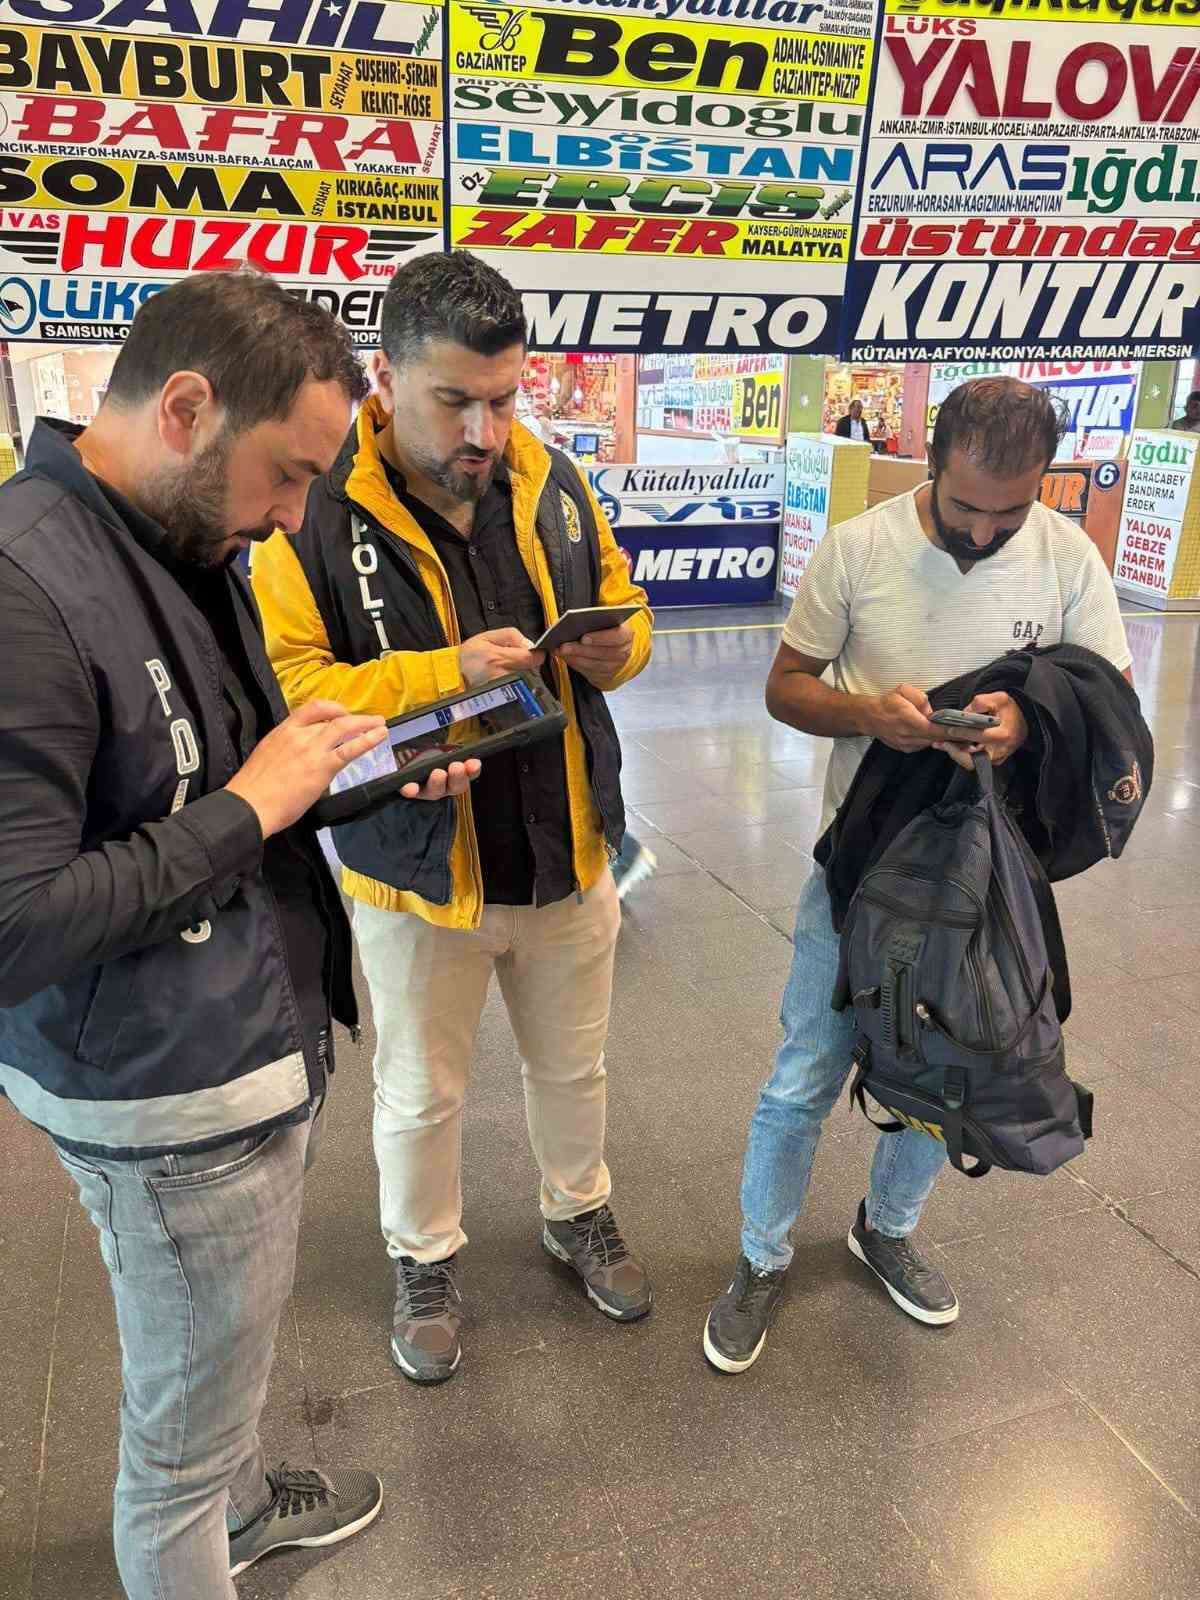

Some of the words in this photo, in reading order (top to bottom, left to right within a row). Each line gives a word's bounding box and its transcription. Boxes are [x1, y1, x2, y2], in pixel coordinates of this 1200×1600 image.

[885, 16, 977, 36] LÜKS
[0, 29, 331, 108] BAYBURT
[531, 12, 769, 91] Ben
[329, 61, 354, 109] SEYAHAT
[11, 94, 422, 171] BAFRA
[422, 124, 441, 174] SEYAHAT
[0, 155, 305, 216] SOMA
[354, 162, 416, 175] YAKAKENT
[870, 141, 1070, 190] ARAS
[1067, 144, 1200, 213] ığdı
[312, 181, 332, 216] SEYAHAT
[61, 214, 369, 281] HUZUR
[363, 264, 398, 276] TUR
[457, 210, 739, 255] ZAFER
[741, 239, 843, 258] MALATYA
[853, 263, 1200, 340] KONTUR
[45, 324, 130, 338] SAMSUN-O
[521, 292, 828, 348] METRO
[741, 377, 782, 428] Ben
[621, 467, 775, 496] Kütahyalılar
[1099, 464, 1115, 485] 6
[1131, 470, 1186, 487] KARACABEY
[1127, 498, 1155, 512] ERDEK
[1126, 518, 1172, 541] YALOVA
[1126, 535, 1167, 556] GEBZE
[633, 546, 775, 582] METRO
[1122, 550, 1165, 573] HAREM
[351, 511, 397, 659] POLİ
[1012, 620, 1044, 641] GAP
